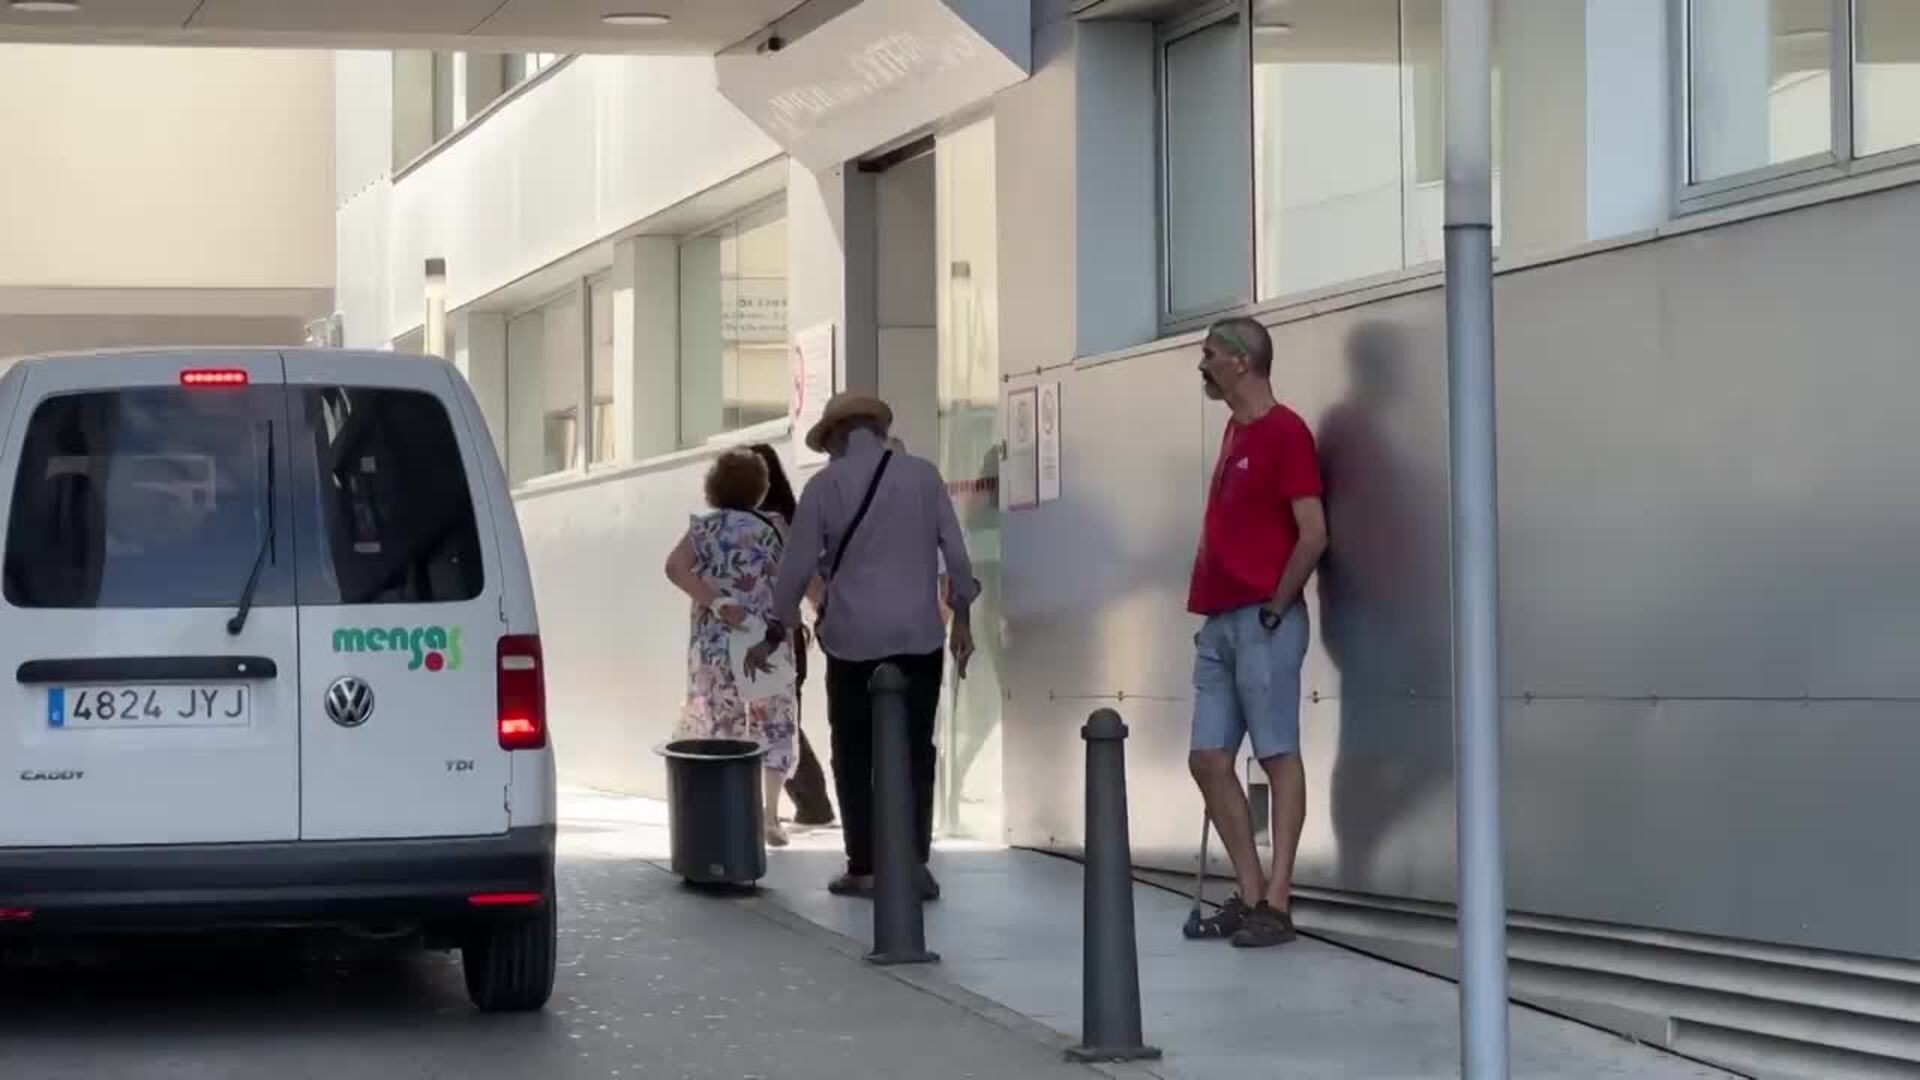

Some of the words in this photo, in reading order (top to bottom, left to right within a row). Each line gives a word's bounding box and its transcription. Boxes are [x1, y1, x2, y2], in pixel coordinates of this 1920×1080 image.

[73, 689, 162, 721] 4824
[177, 688, 243, 718] JYJ
[445, 760, 475, 771] TDI
